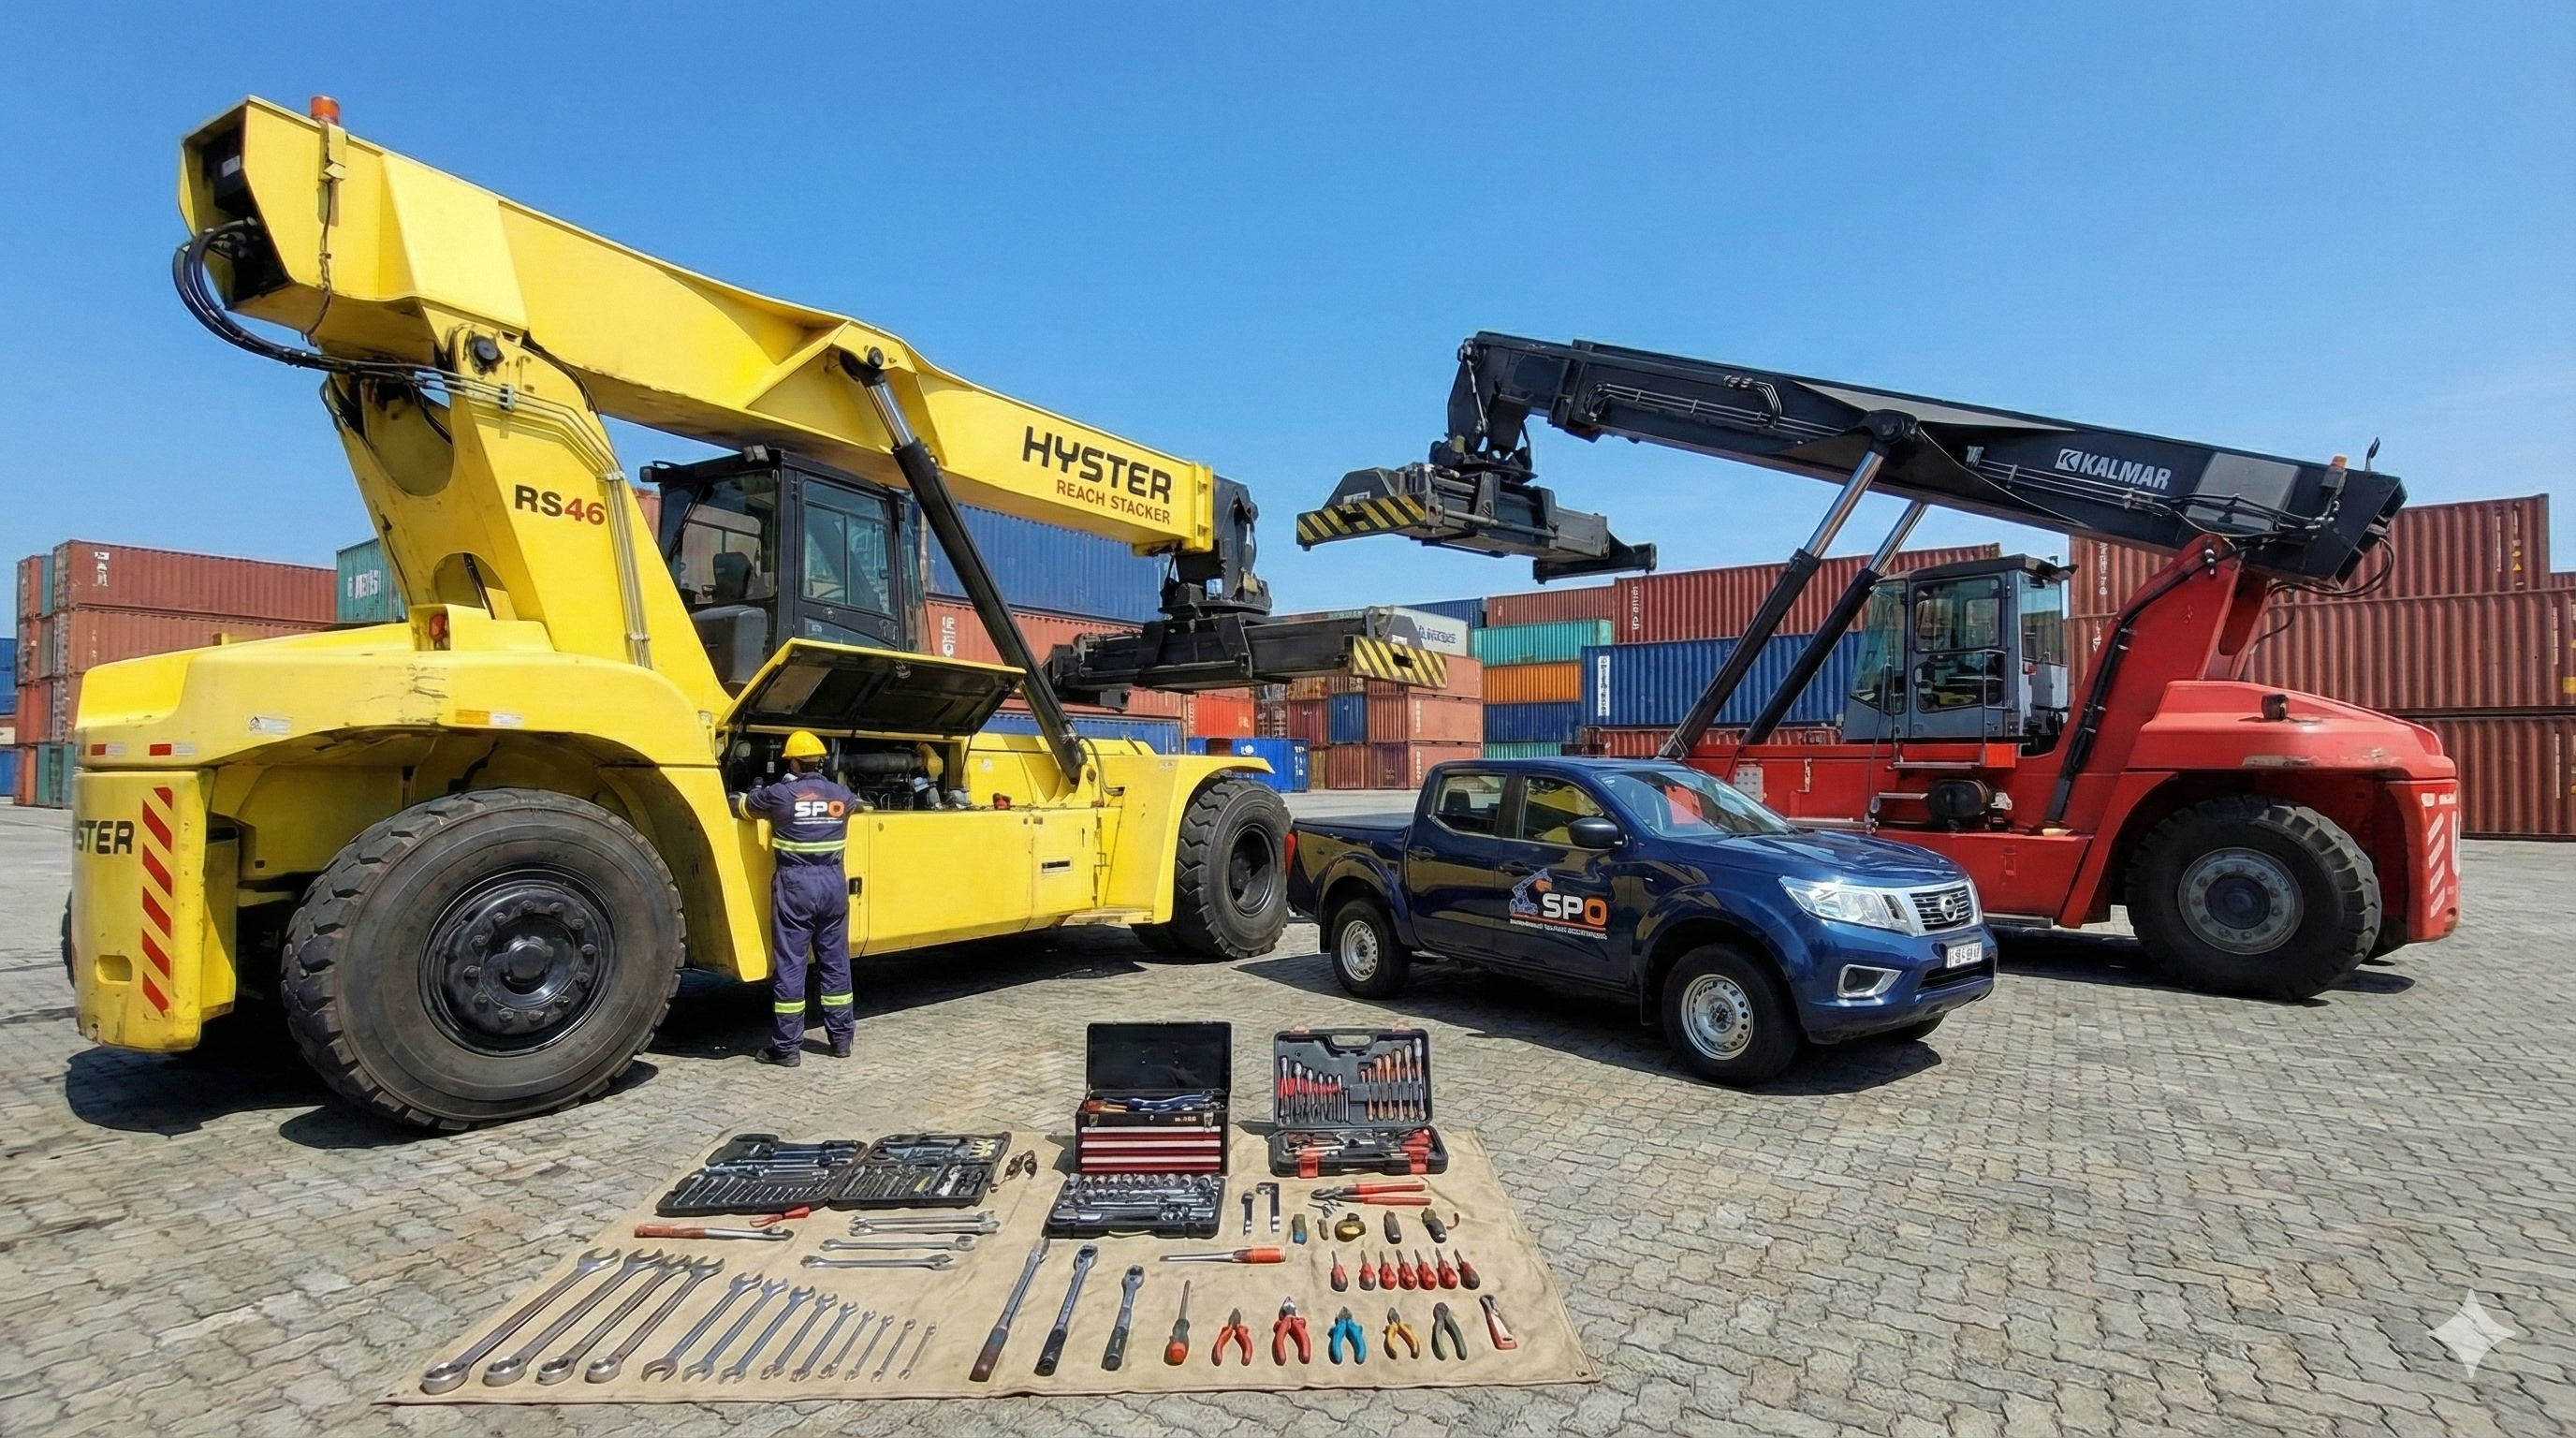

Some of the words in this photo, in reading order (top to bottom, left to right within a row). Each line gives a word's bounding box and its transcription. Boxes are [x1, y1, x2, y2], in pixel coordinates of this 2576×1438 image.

[1022, 425, 1172, 505] HYSTER
[2079, 452, 2172, 491] KALMAR
[515, 484, 606, 526] RS46
[1056, 479, 1105, 506] REACH
[1110, 495, 1171, 525] STACKER
[794, 800, 845, 817] SPO
[1542, 892, 1608, 926] SPO
